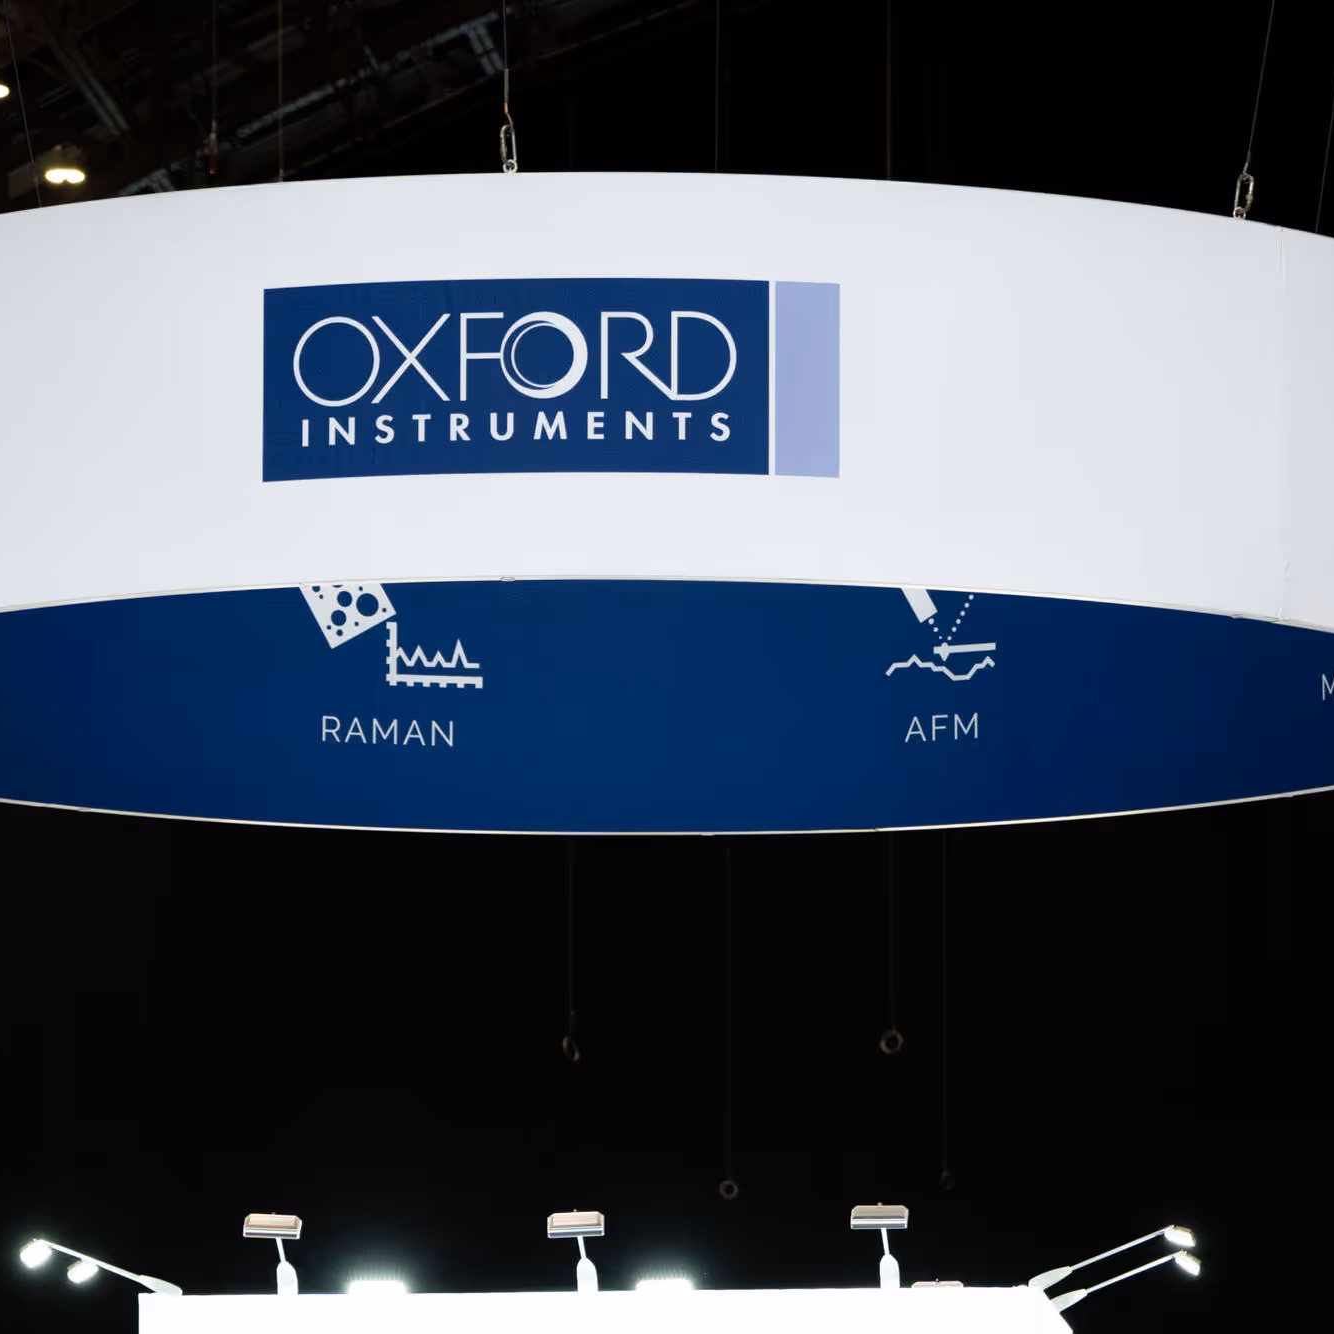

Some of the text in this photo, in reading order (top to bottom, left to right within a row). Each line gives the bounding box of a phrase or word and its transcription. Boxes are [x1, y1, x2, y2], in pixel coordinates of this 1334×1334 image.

[293, 310, 737, 407] OXFORD
[300, 410, 733, 448] INSTRUMENTS
[320, 714, 456, 749] RAMAN
[904, 712, 980, 743] AFM
